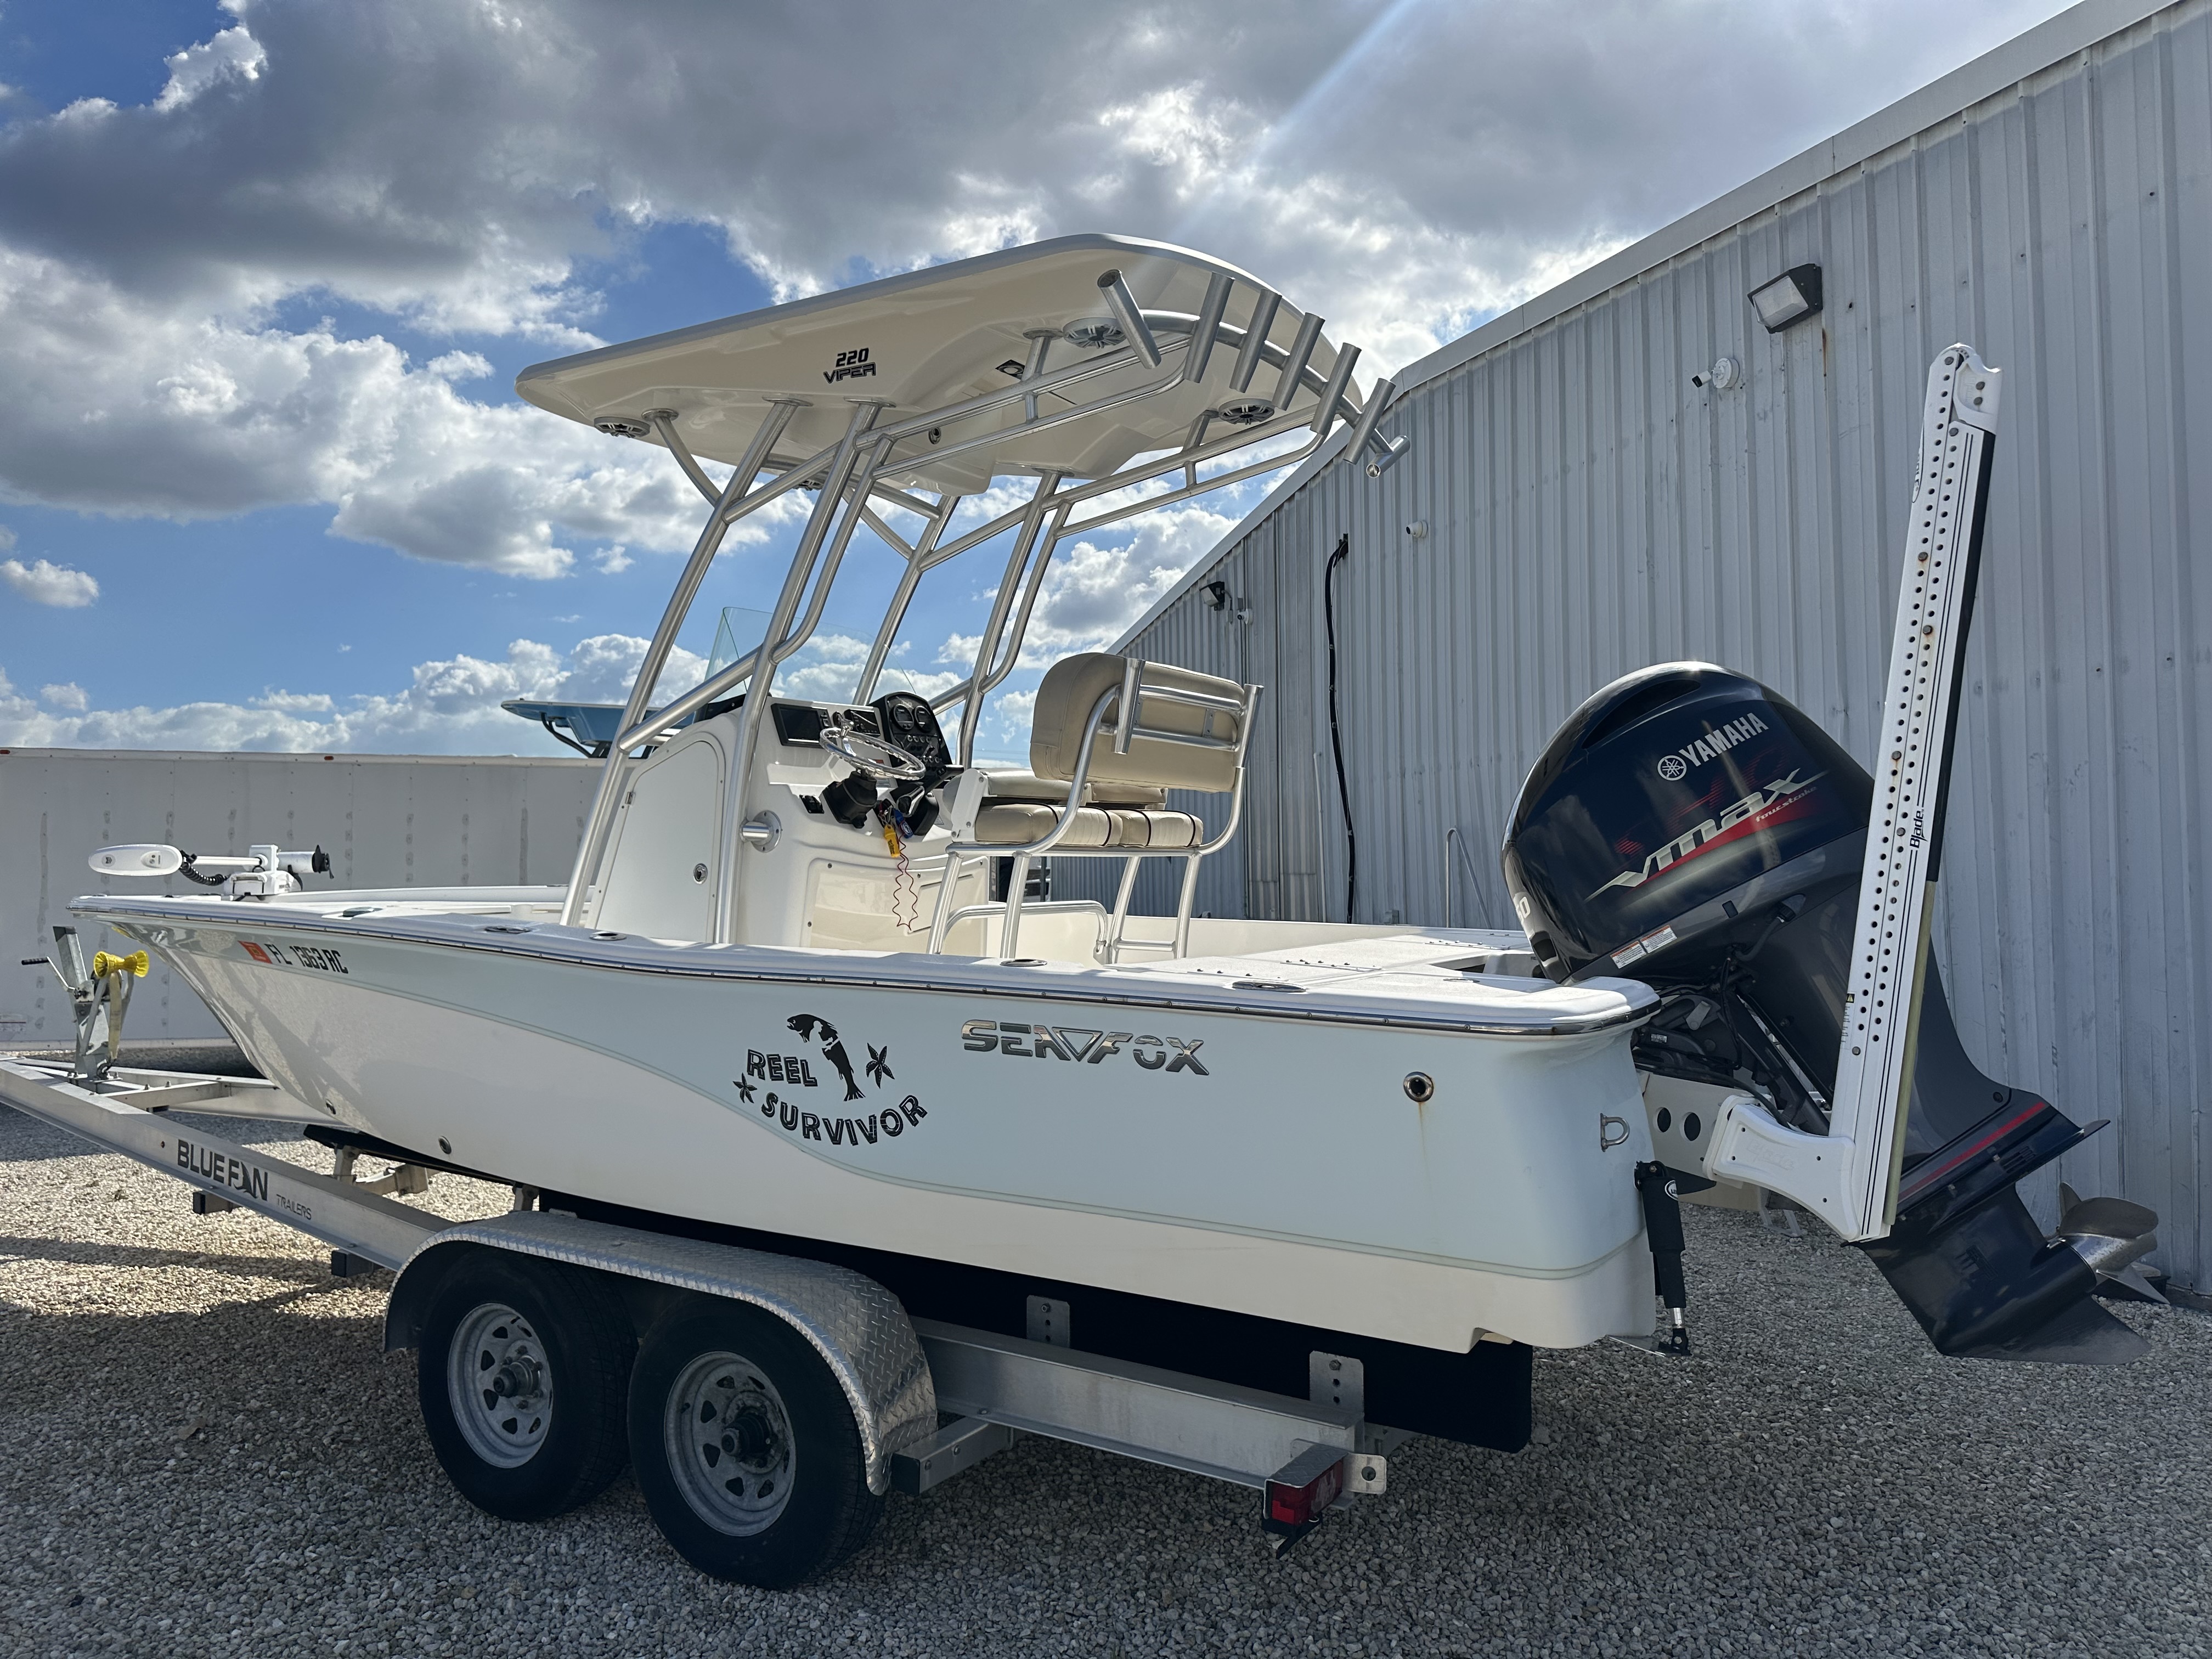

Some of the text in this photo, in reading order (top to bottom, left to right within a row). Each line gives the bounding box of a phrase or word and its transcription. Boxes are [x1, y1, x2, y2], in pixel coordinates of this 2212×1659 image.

[823, 362, 877, 384] VIPER
[836, 347, 869, 368] 220
[1679, 713, 1769, 767] YAMAHA
[1910, 810, 1928, 849] Blade
[264, 943, 293, 965] FL
[289, 945, 329, 970] 1363
[321, 949, 349, 974] RC
[746, 1048, 818, 1087] REEL
[761, 1094, 928, 1147] SURVIVOR
[178, 1139, 225, 1184] BLUE
[276, 1194, 312, 1221] TRAILERS
